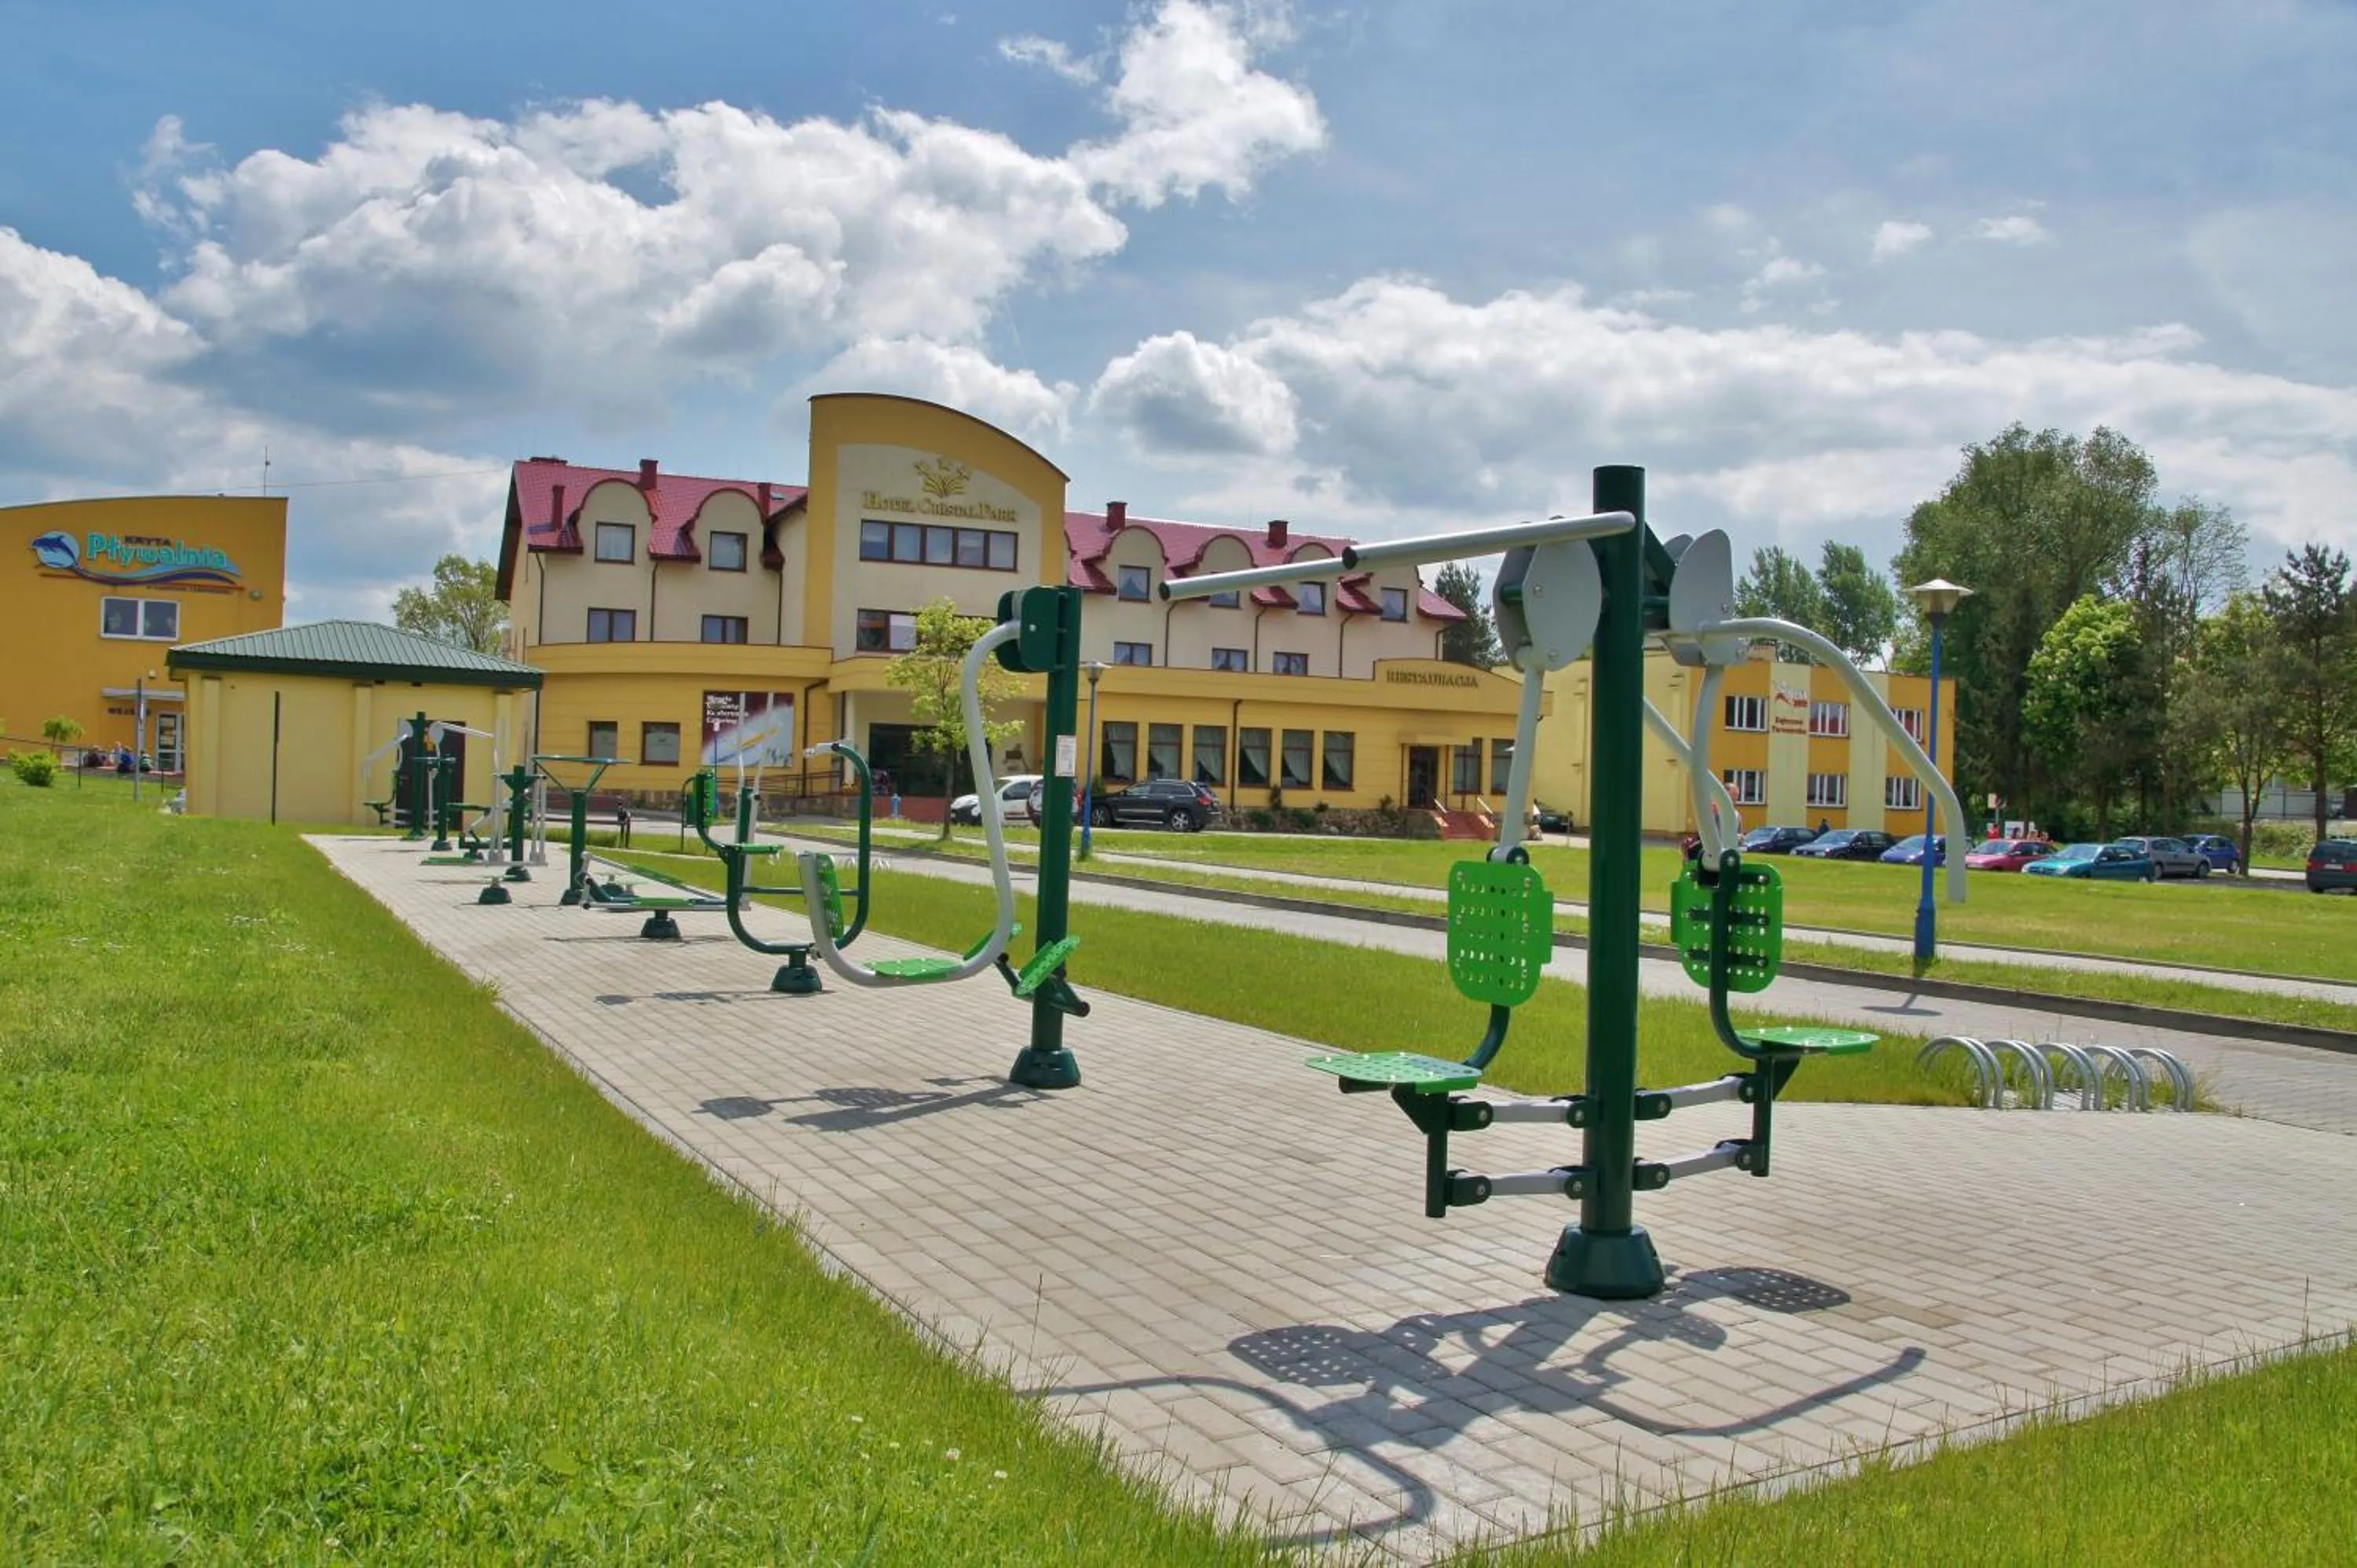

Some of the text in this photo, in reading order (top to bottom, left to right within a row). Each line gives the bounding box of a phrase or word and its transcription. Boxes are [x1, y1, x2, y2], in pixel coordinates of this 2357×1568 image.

[862, 490, 915, 513] HOTEL
[979, 502, 1017, 523] PARK
[1386, 669, 1479, 688] RESTAURACJA
